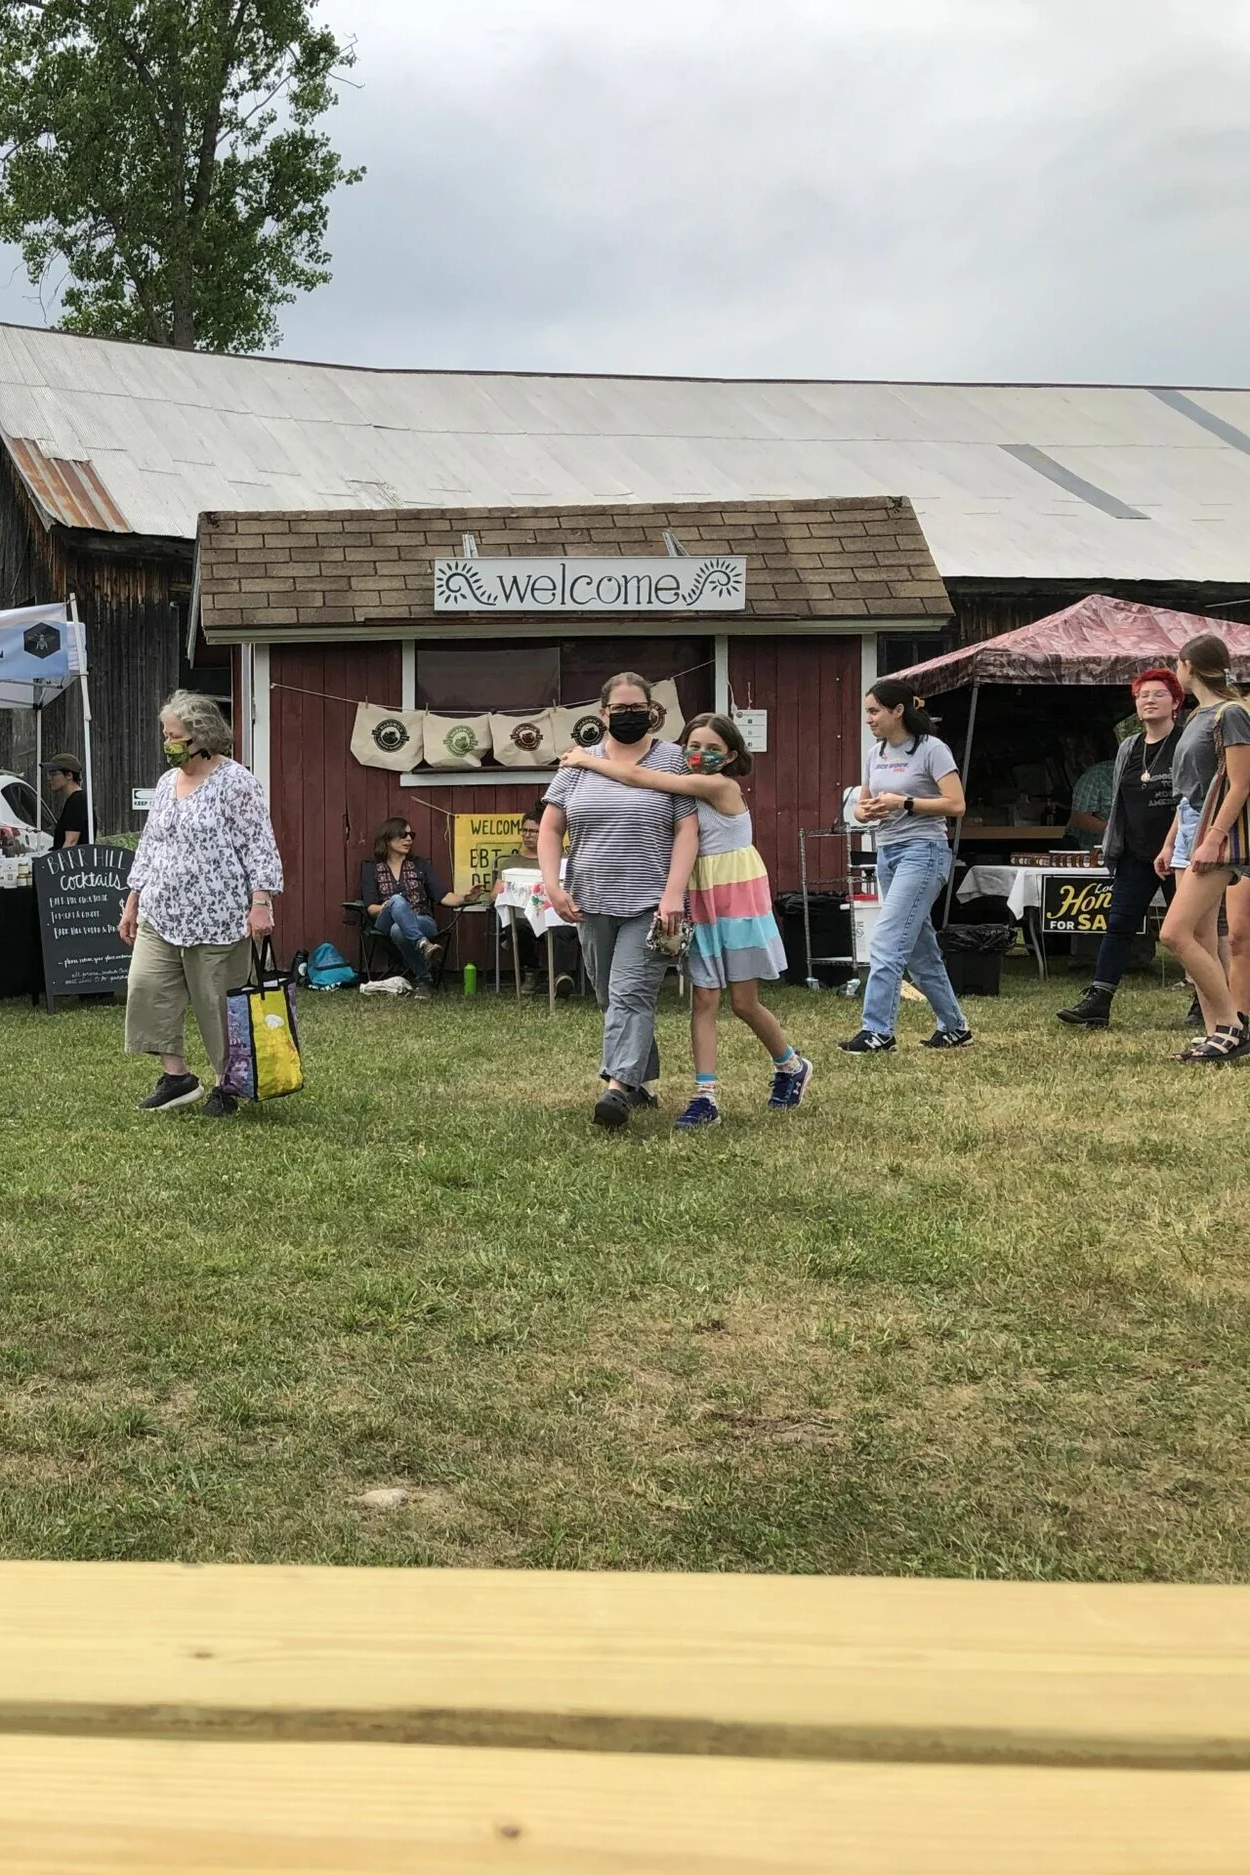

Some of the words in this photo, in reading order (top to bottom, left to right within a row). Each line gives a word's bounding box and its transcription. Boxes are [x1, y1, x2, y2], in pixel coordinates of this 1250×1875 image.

[497, 563, 680, 605] welcome
[471, 820, 522, 835] WELCOM
[47, 849, 89, 875] BARR
[94, 848, 125, 870] HILL
[470, 849, 501, 868] EBT
[1094, 883, 1114, 894] Loc
[1046, 883, 1112, 919] Hon
[1050, 921, 1075, 930] FOR
[1077, 914, 1107, 930] SA
